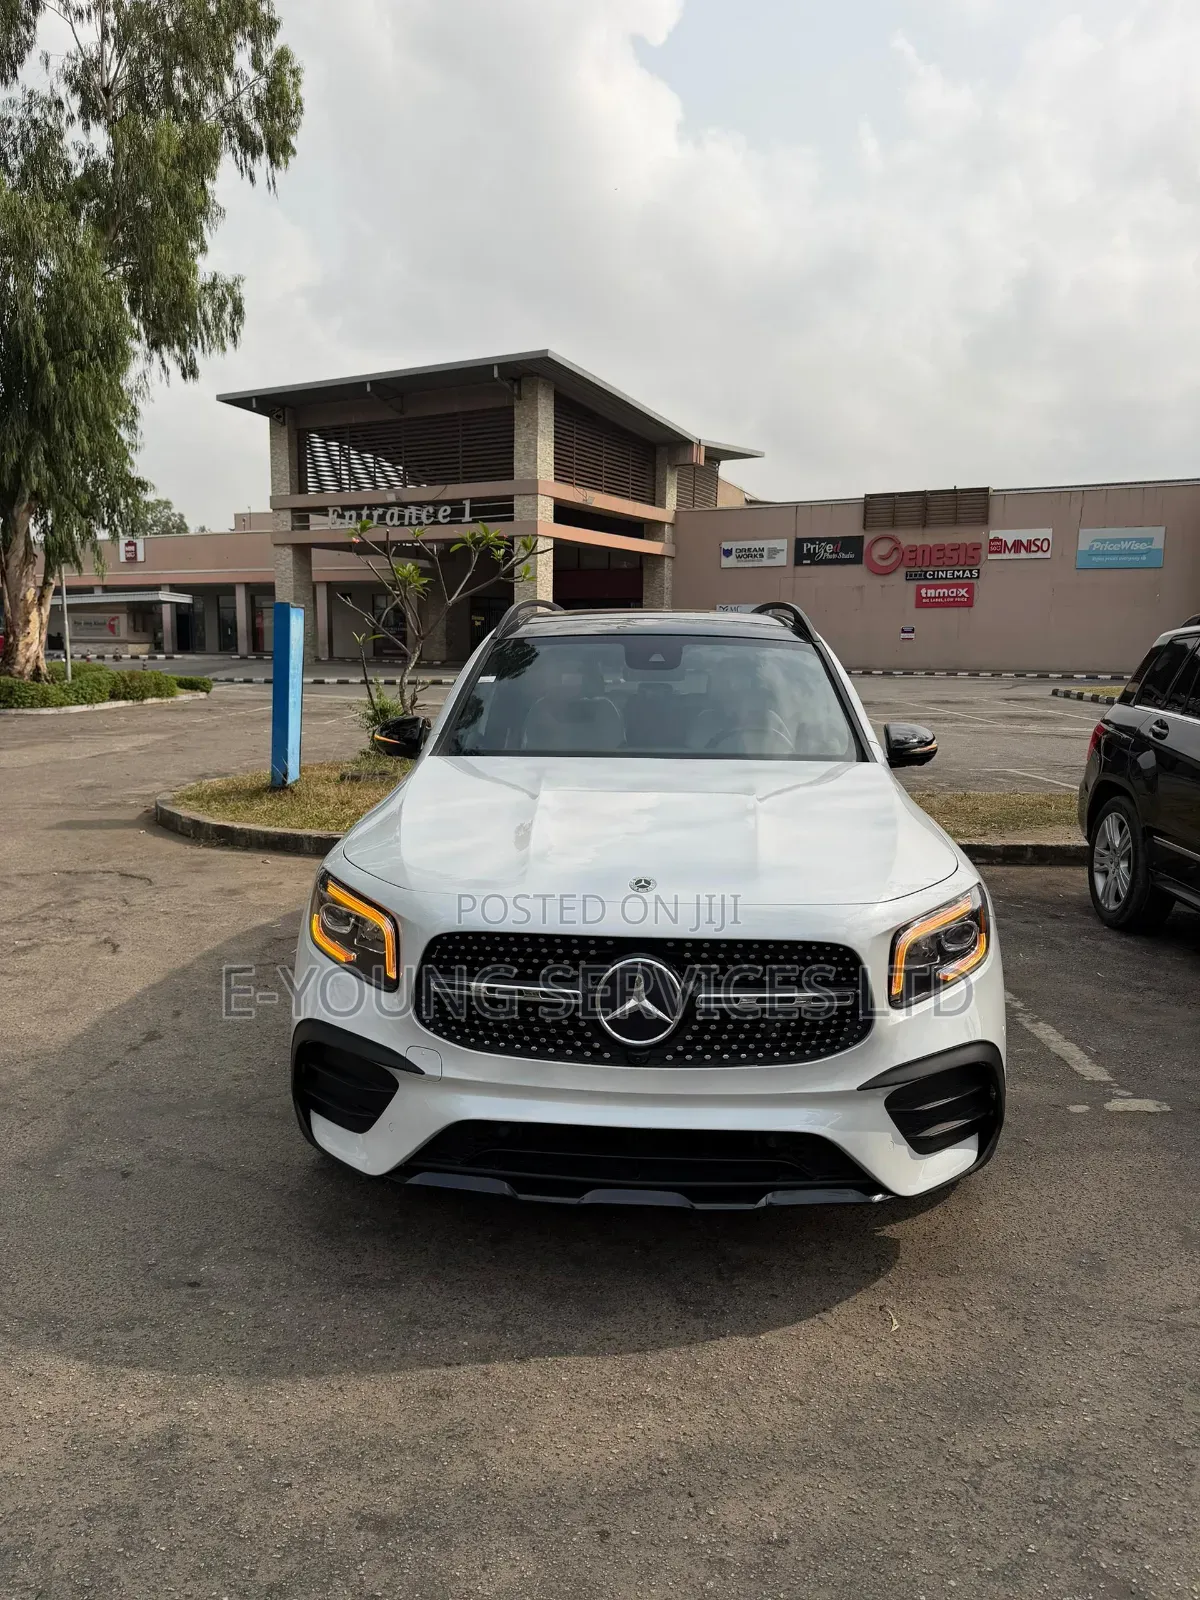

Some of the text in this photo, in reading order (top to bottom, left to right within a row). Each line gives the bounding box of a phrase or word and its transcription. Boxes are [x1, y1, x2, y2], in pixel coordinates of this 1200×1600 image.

[327, 498, 473, 529] Entrance 1
[802, 540, 842, 561] Prized
[1003, 538, 1051, 554] MINISO
[1092, 540, 1150, 551] PriceWise
[926, 569, 979, 579] CINEMAS
